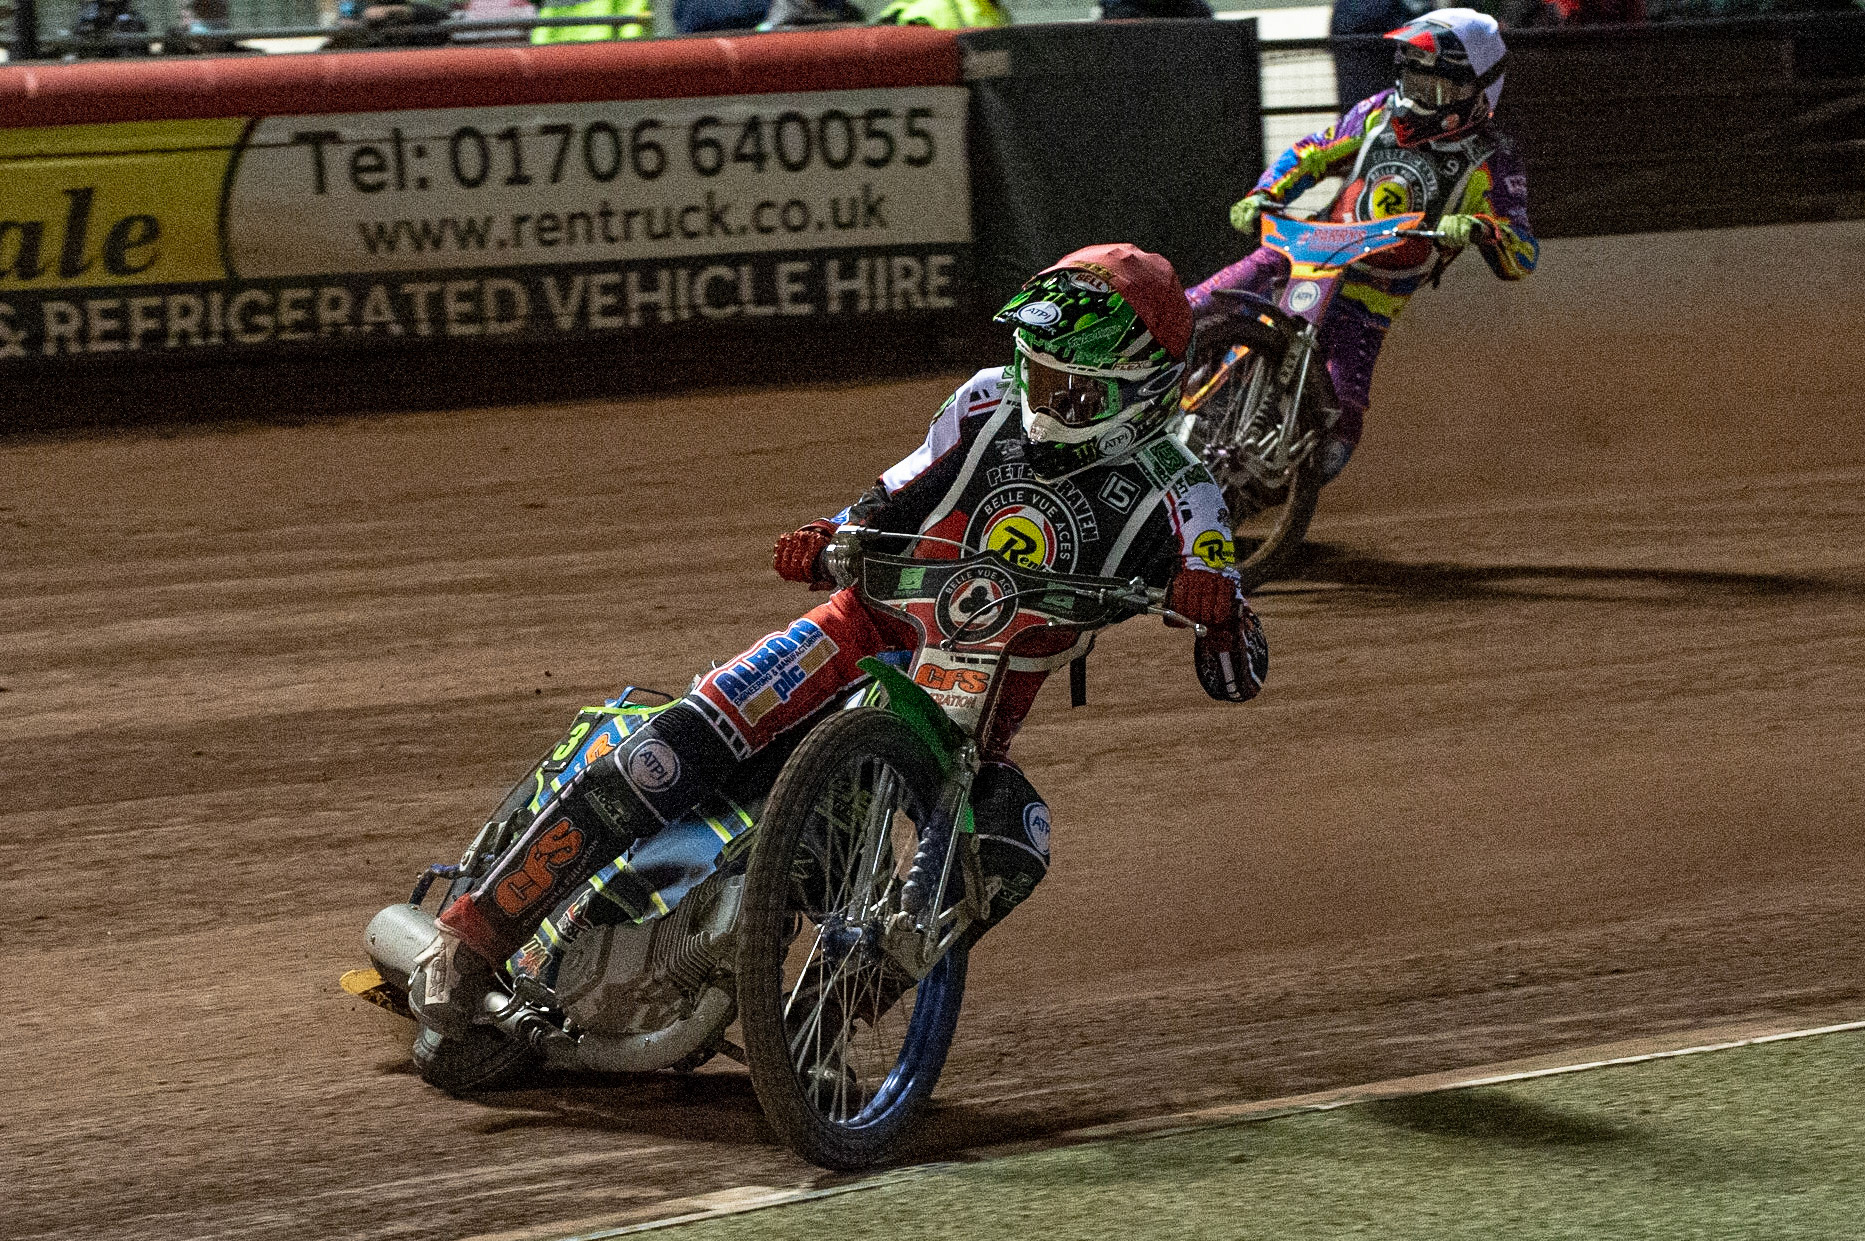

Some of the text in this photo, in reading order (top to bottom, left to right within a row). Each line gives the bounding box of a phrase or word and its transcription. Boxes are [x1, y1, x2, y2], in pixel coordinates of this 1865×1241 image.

[292, 107, 935, 195] Tel: 01706 640055
[357, 183, 887, 256] www.rentruck.co.uk
[1075, 273, 1104, 290] BELL
[42, 277, 528, 356] REFRIGERATED
[543, 261, 811, 332] VEHICLE
[827, 254, 956, 312] HIRE
[1027, 306, 1052, 321] ATPI
[1103, 433, 1130, 449] ATPI
[987, 463, 1099, 542] PETE RAVEN
[1102, 475, 1136, 508] 15
[983, 490, 1071, 561] BELLE VUE ACES
[945, 568, 1015, 595] BELLE VUE ACE
[734, 673, 773, 706] ENGINEERING
[777, 630, 824, 672] MANUFACTURING
[772, 665, 806, 701] plc
[914, 662, 990, 694] CFS
[552, 722, 591, 761] 3
[640, 750, 669, 780] ATPI
[495, 817, 585, 917] CFS
